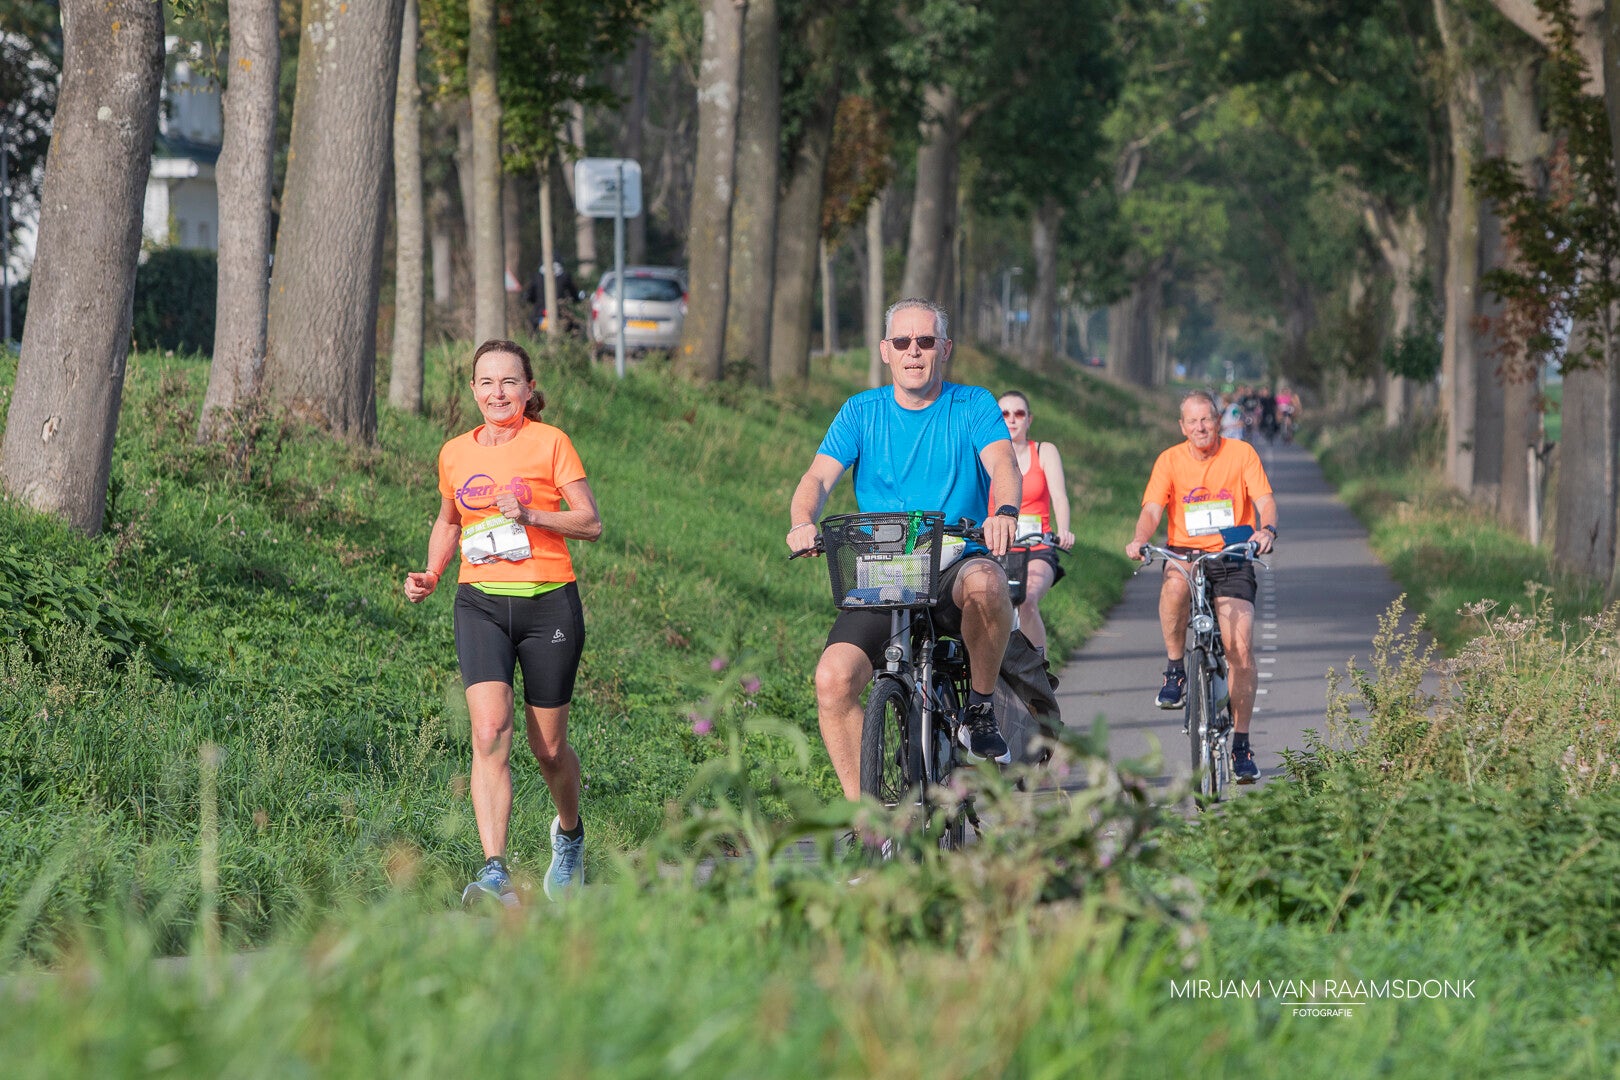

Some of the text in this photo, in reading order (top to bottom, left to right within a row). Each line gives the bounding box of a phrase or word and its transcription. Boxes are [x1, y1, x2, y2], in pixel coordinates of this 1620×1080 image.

[456, 484, 498, 500] SPIRIT
[1207, 512, 1212, 525] 1
[486, 531, 497, 552] 1
